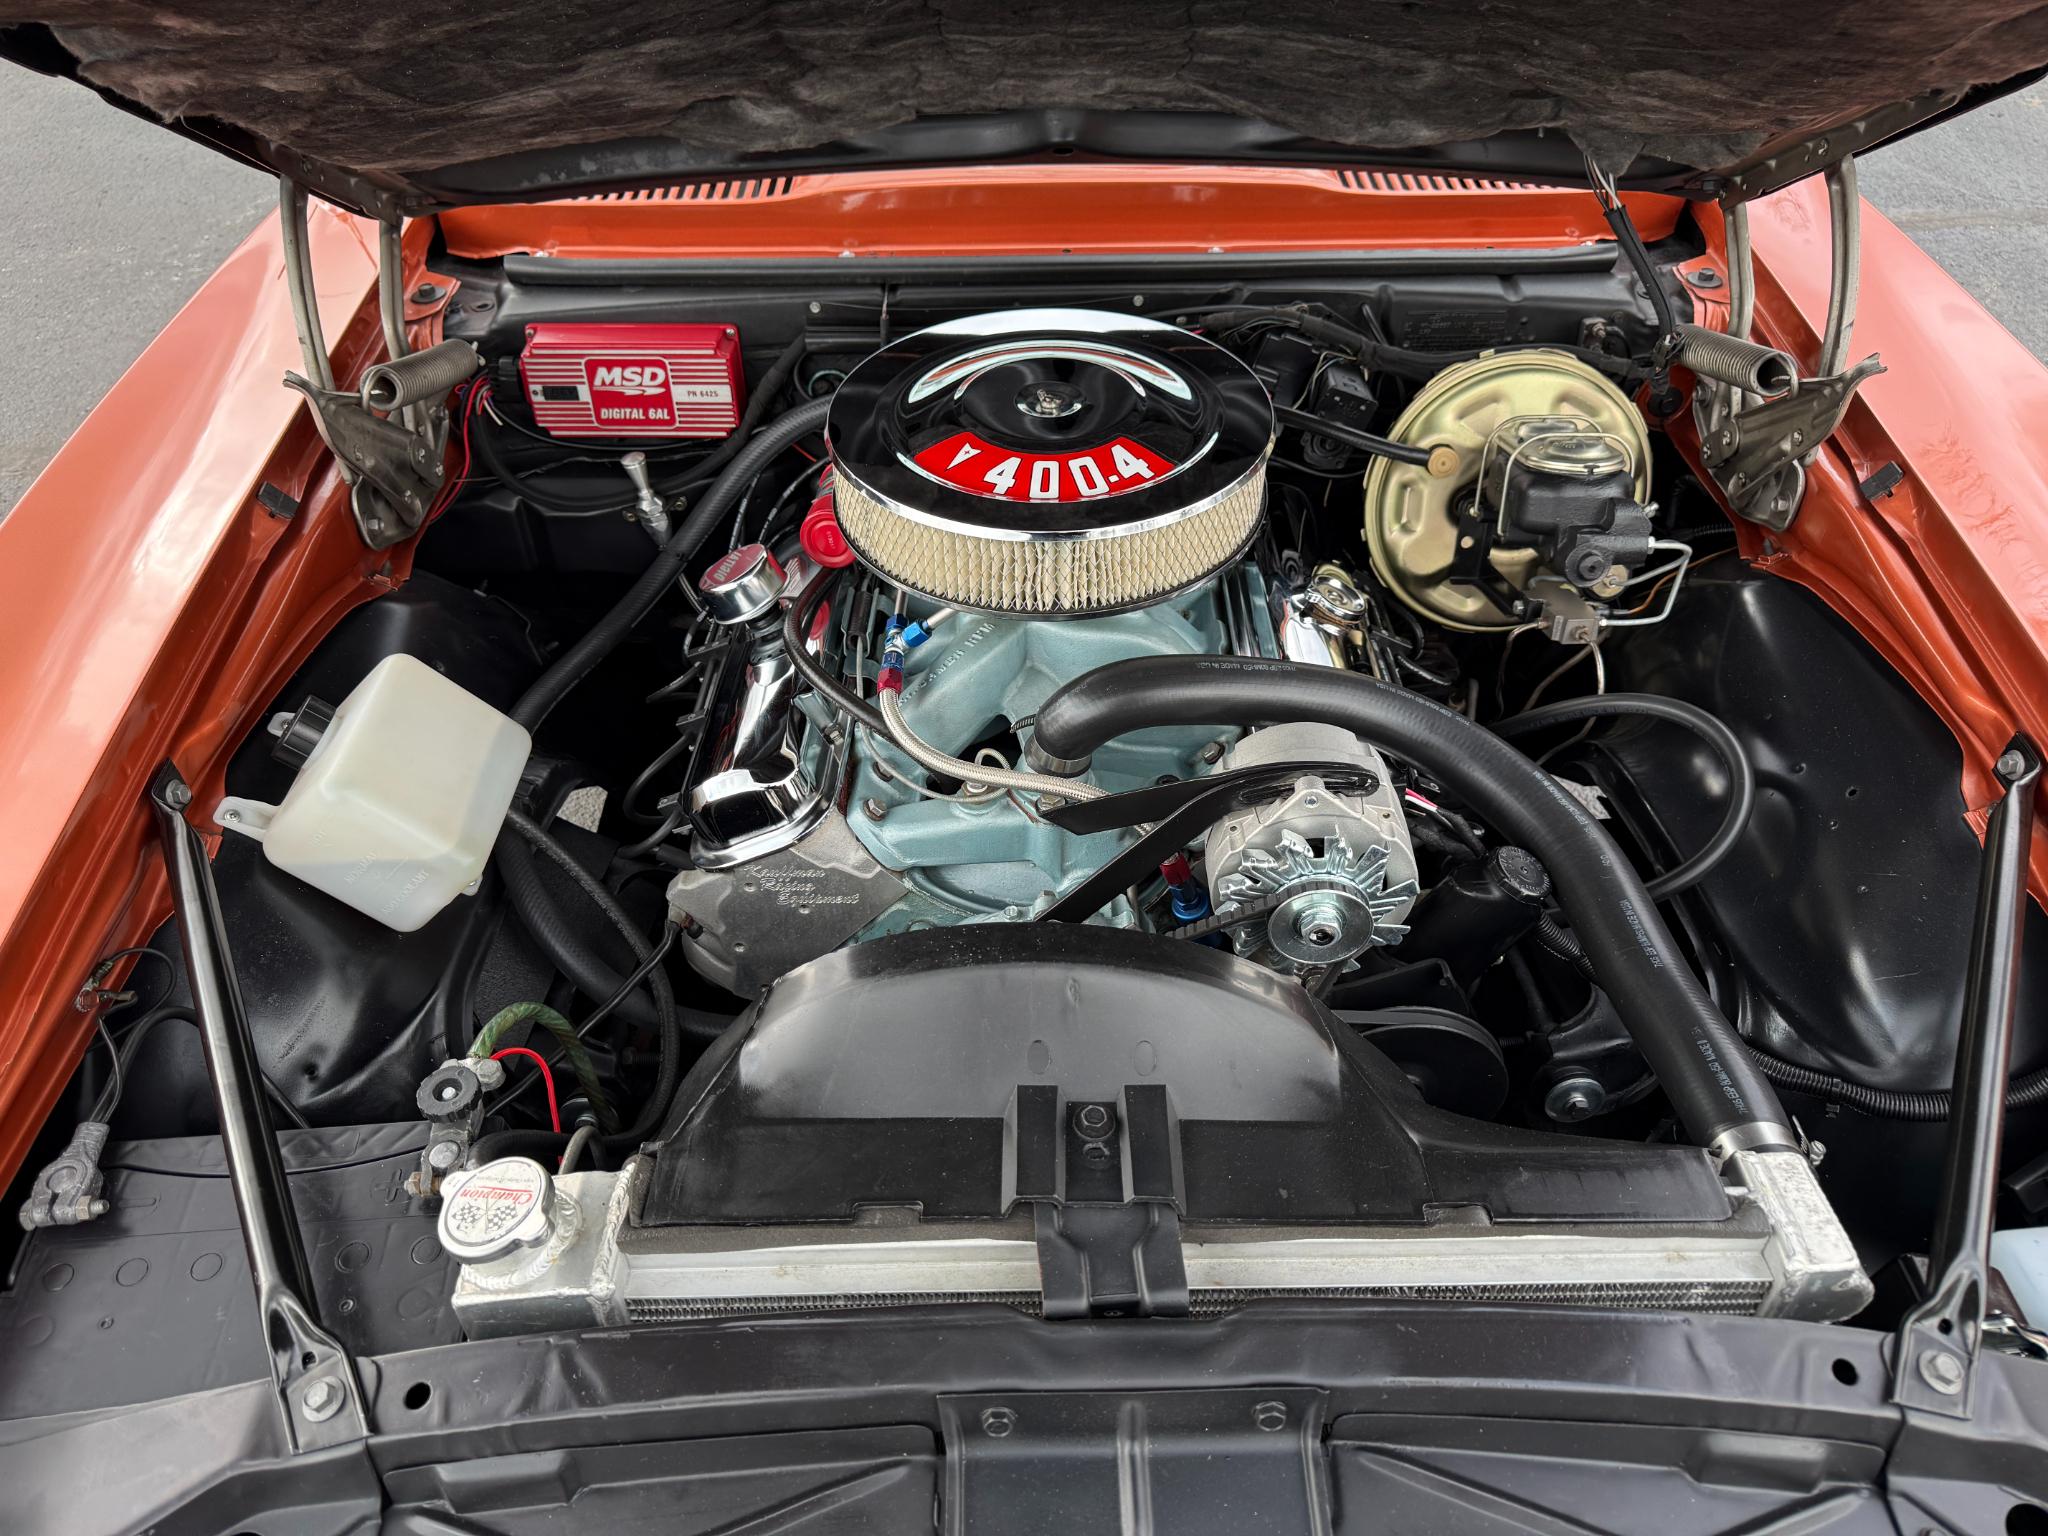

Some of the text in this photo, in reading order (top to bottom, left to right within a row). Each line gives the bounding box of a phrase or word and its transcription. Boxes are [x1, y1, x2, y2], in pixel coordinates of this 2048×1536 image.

[593, 366, 666, 387] MSD
[687, 390, 698, 398] PN
[601, 408, 671, 419] DIGITAL 6AL
[460, 1185, 533, 1205] Champion
